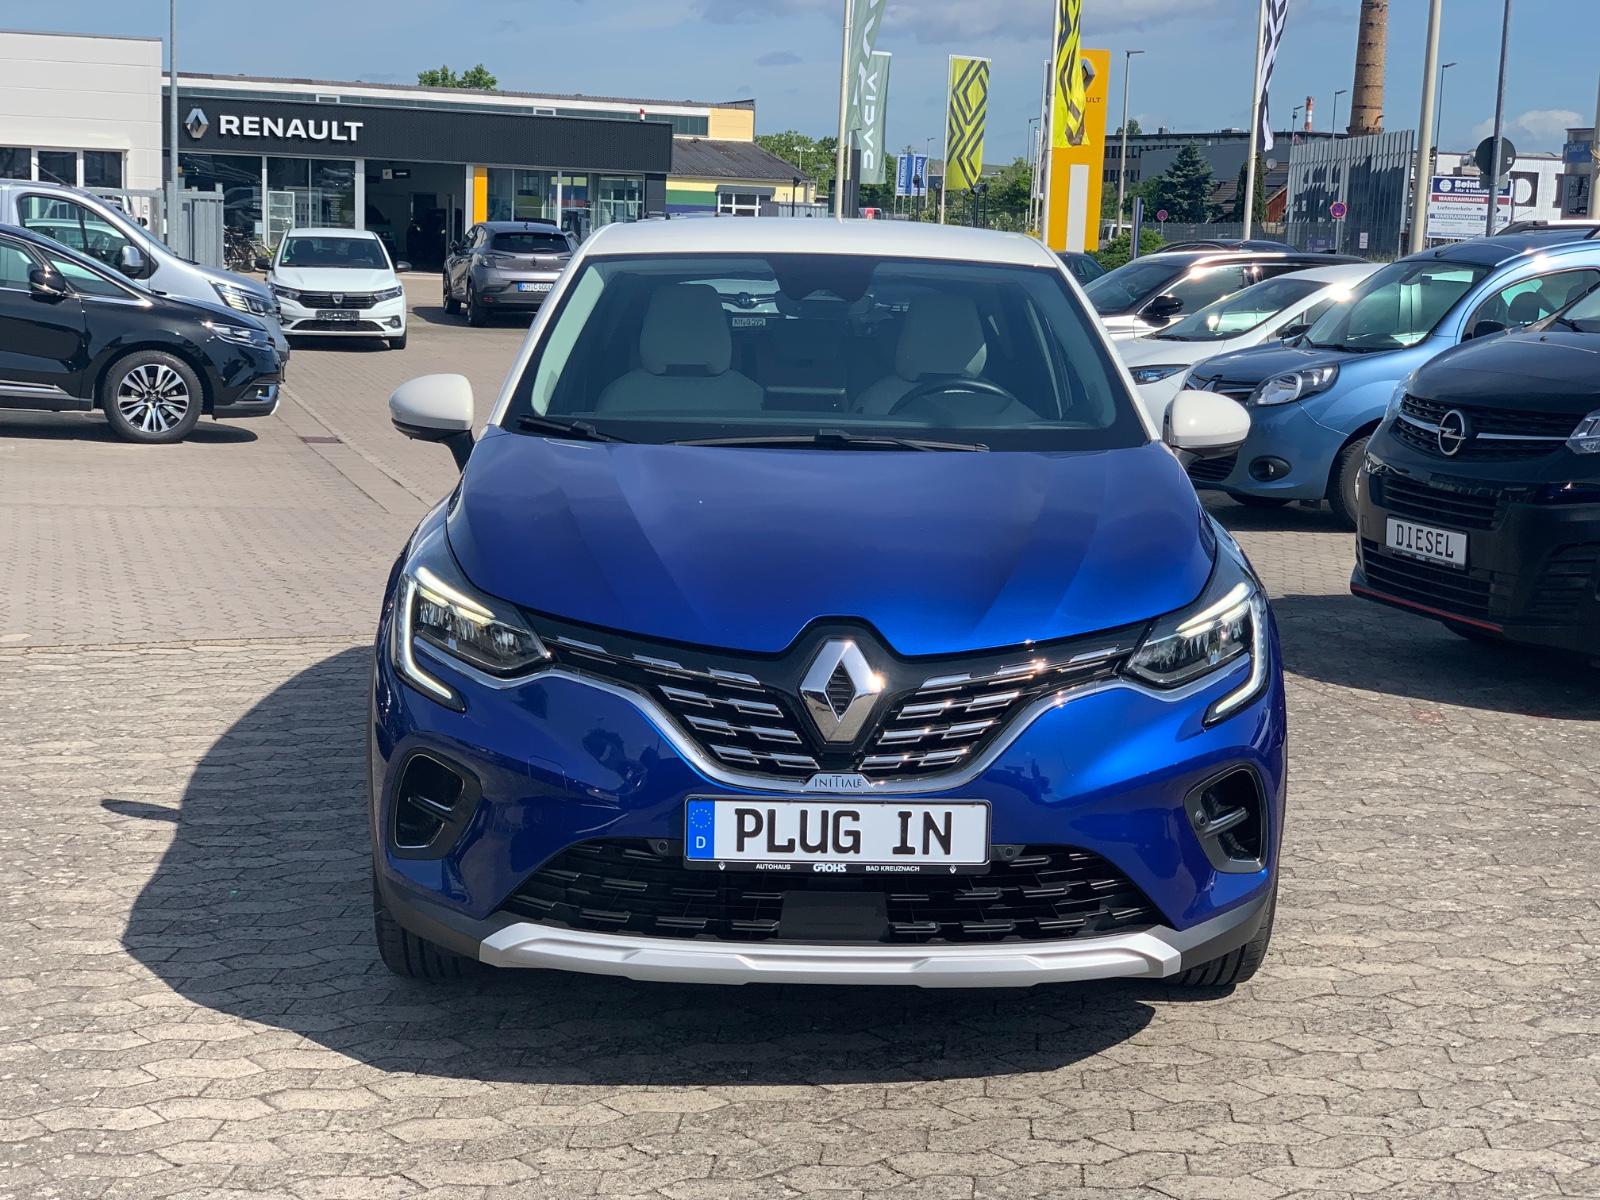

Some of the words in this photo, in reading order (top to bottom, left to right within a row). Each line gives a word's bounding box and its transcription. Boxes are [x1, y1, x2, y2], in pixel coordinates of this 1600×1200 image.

[219, 115, 364, 142] RENAULT
[1395, 523, 1454, 559] DIESEL
[814, 775, 862, 789] INITIALE
[734, 807, 861, 855] PLUG
[892, 810, 953, 856] IN
[695, 836, 706, 849] D
[812, 863, 847, 873] GROHS
